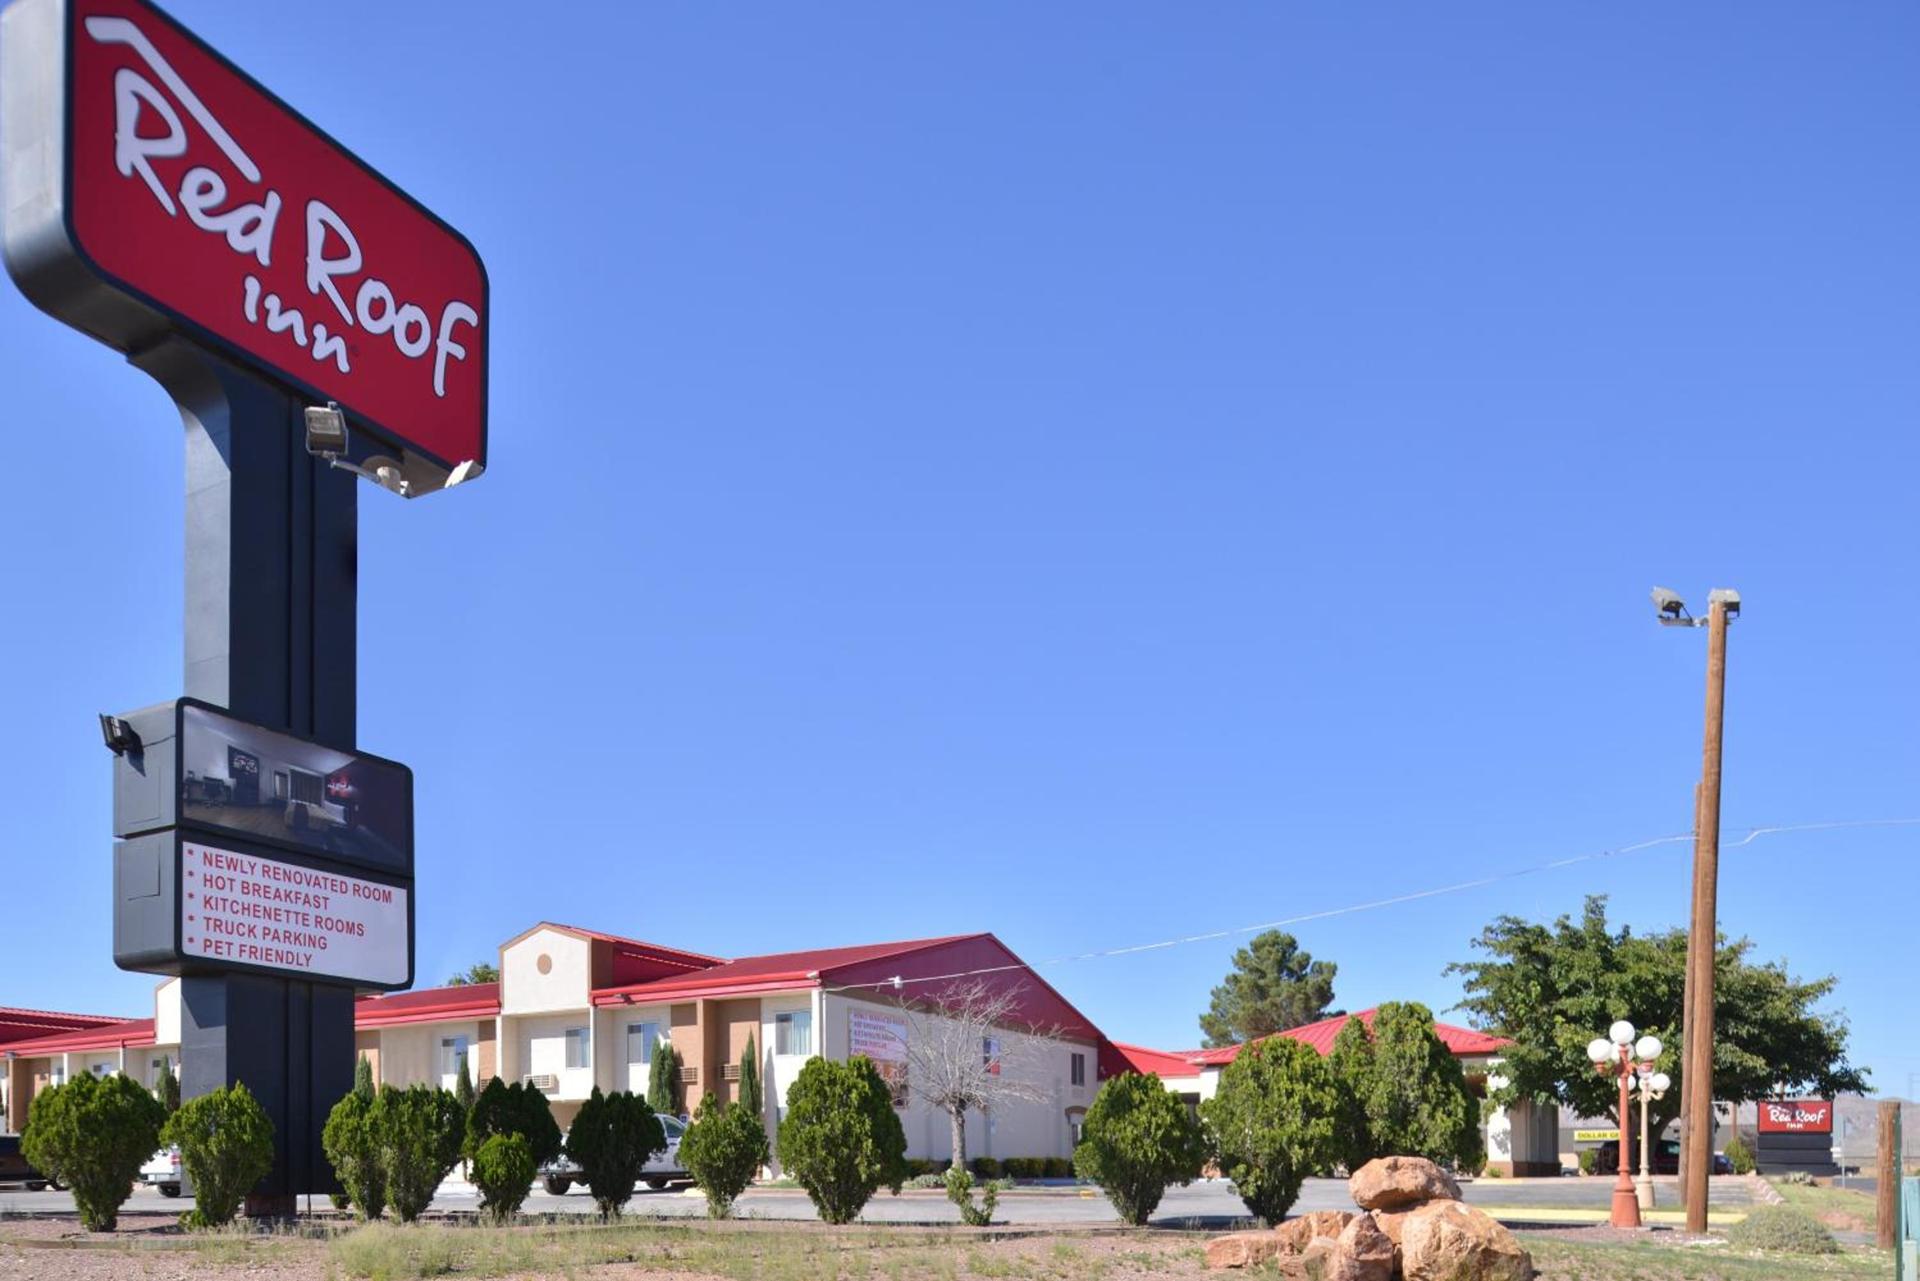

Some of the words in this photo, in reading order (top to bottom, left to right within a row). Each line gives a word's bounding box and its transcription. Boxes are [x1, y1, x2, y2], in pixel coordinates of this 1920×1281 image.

[114, 67, 281, 267] Red
[305, 199, 478, 398] Roof
[202, 851, 257, 876] NEWLY
[261, 864, 348, 894] RENOVATED
[352, 883, 393, 904] ROOM
[203, 874, 236, 893] HOT
[241, 881, 330, 910] BREAKFAST
[203, 896, 310, 927] KITCHENETTE
[314, 915, 365, 937] ROOMS
[203, 916, 257, 939] TRUCK
[262, 926, 328, 950] PARKING
[203, 939, 234, 957] PET
[238, 943, 312, 967] FRIENDLY
[1795, 1108, 1826, 1125] Roof
